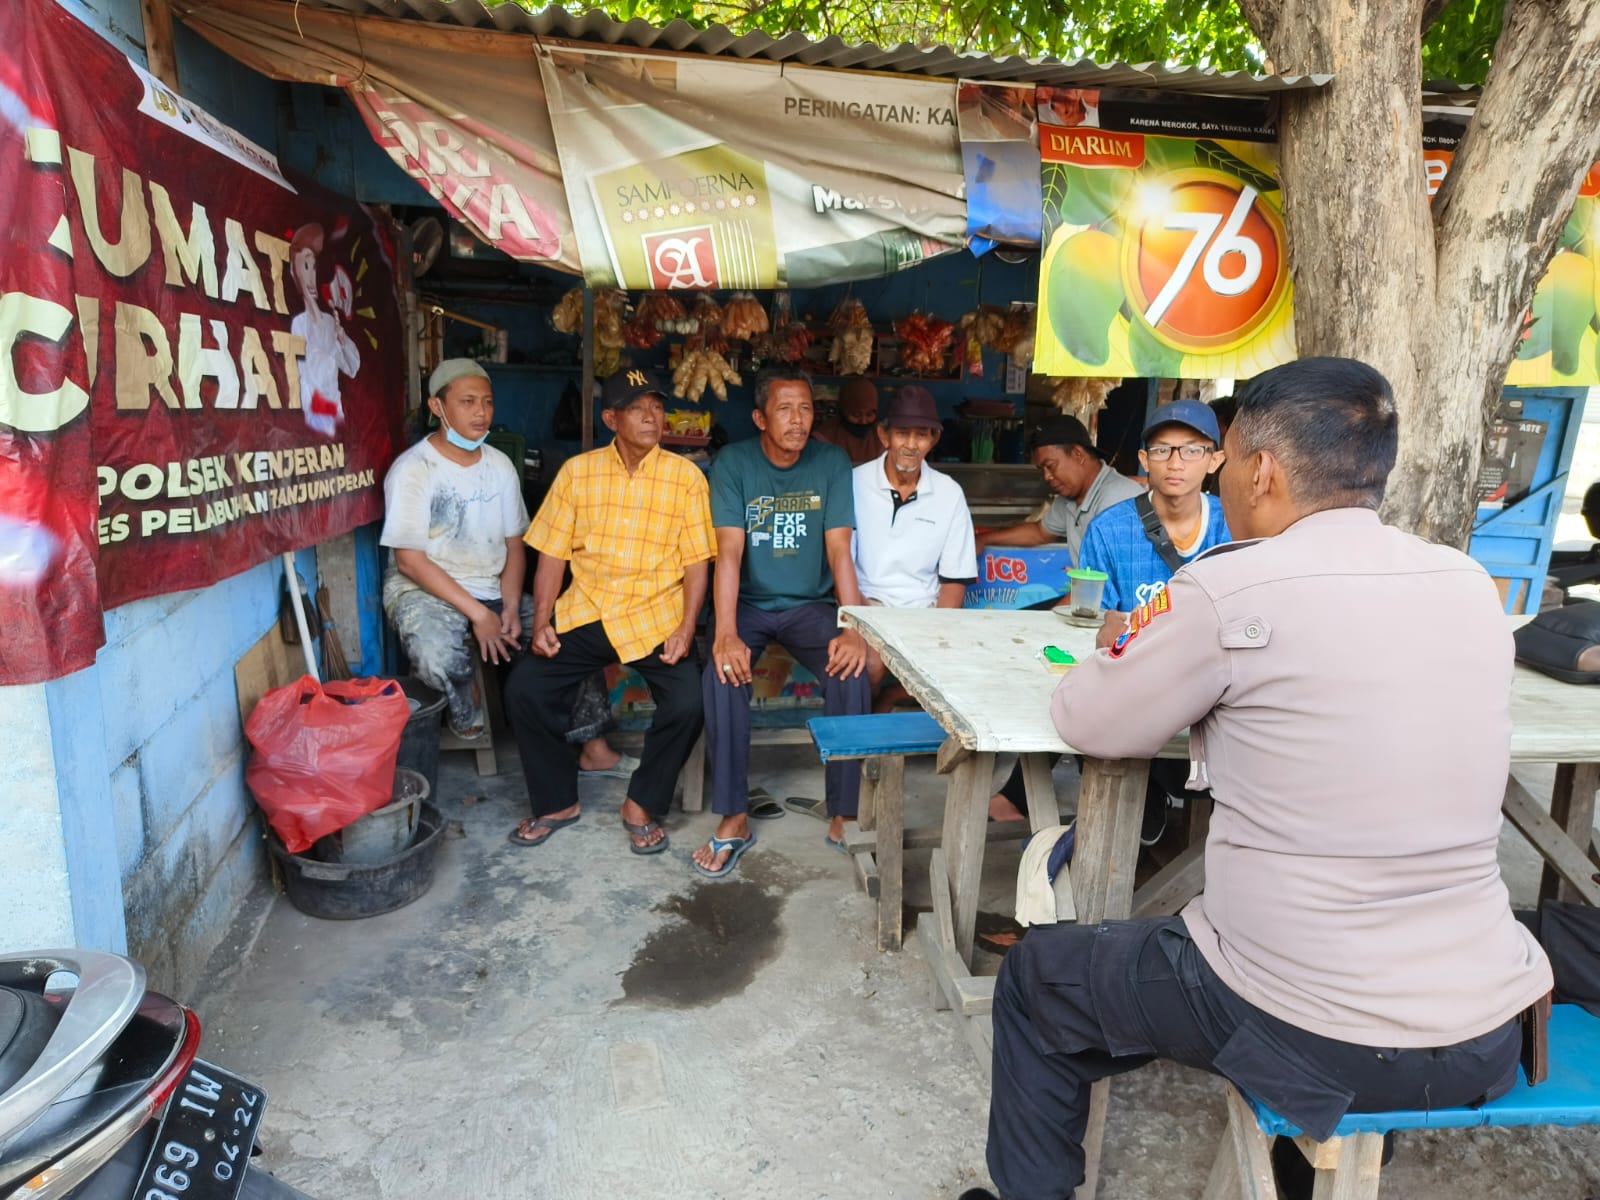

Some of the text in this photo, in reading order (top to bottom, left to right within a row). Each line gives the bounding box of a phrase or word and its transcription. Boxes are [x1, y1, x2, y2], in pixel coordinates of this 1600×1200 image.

[784, 97, 959, 128] PERINGATAN: KA
[1049, 133, 1133, 159] DJARUM
[1143, 185, 1263, 328] 76
[97, 443, 345, 505] POLSEK KENJERAN
[773, 512, 806, 525] EXP
[773, 524, 808, 537] LOR
[772, 536, 801, 549] ER.
[985, 553, 1028, 584] ice
[180, 1070, 224, 1118] IW
